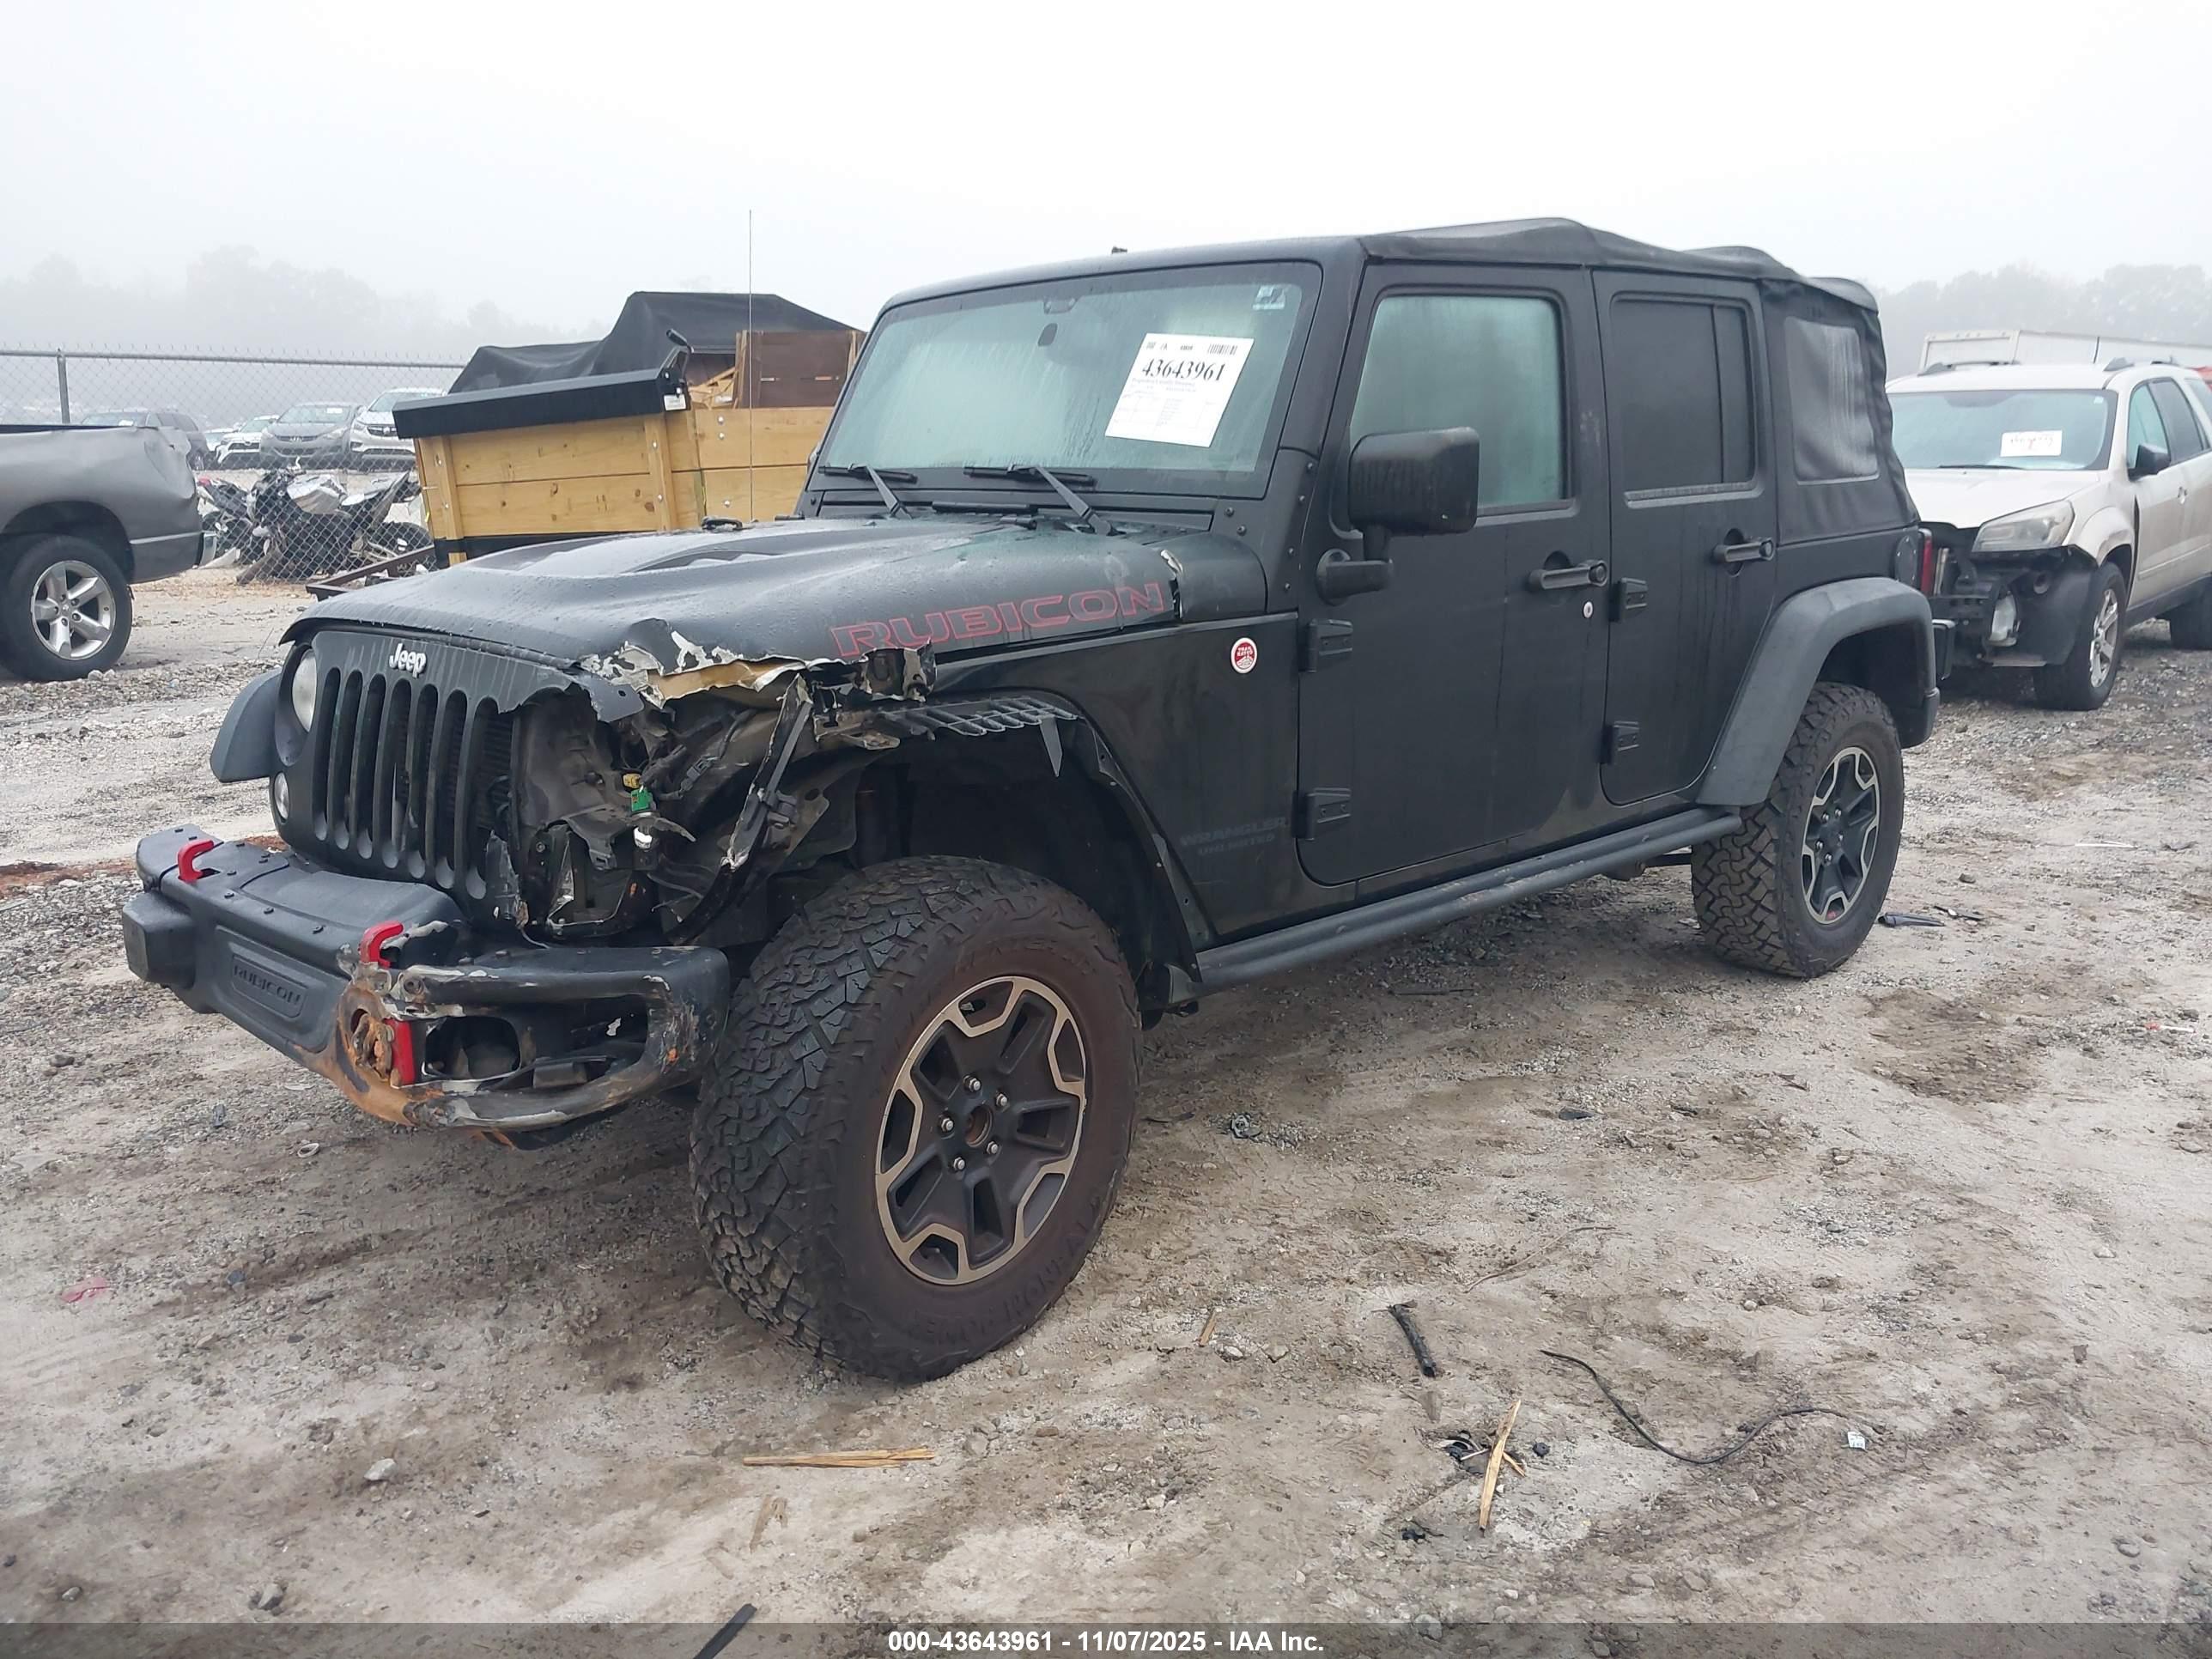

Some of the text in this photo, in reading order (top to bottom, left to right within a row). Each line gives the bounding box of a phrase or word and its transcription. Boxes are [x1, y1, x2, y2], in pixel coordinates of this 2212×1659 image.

[1142, 358, 1226, 381] 43643961
[830, 582, 1165, 657] RUBICON
[389, 642, 427, 678] Jeep
[234, 965, 301, 1005] RUBICON
